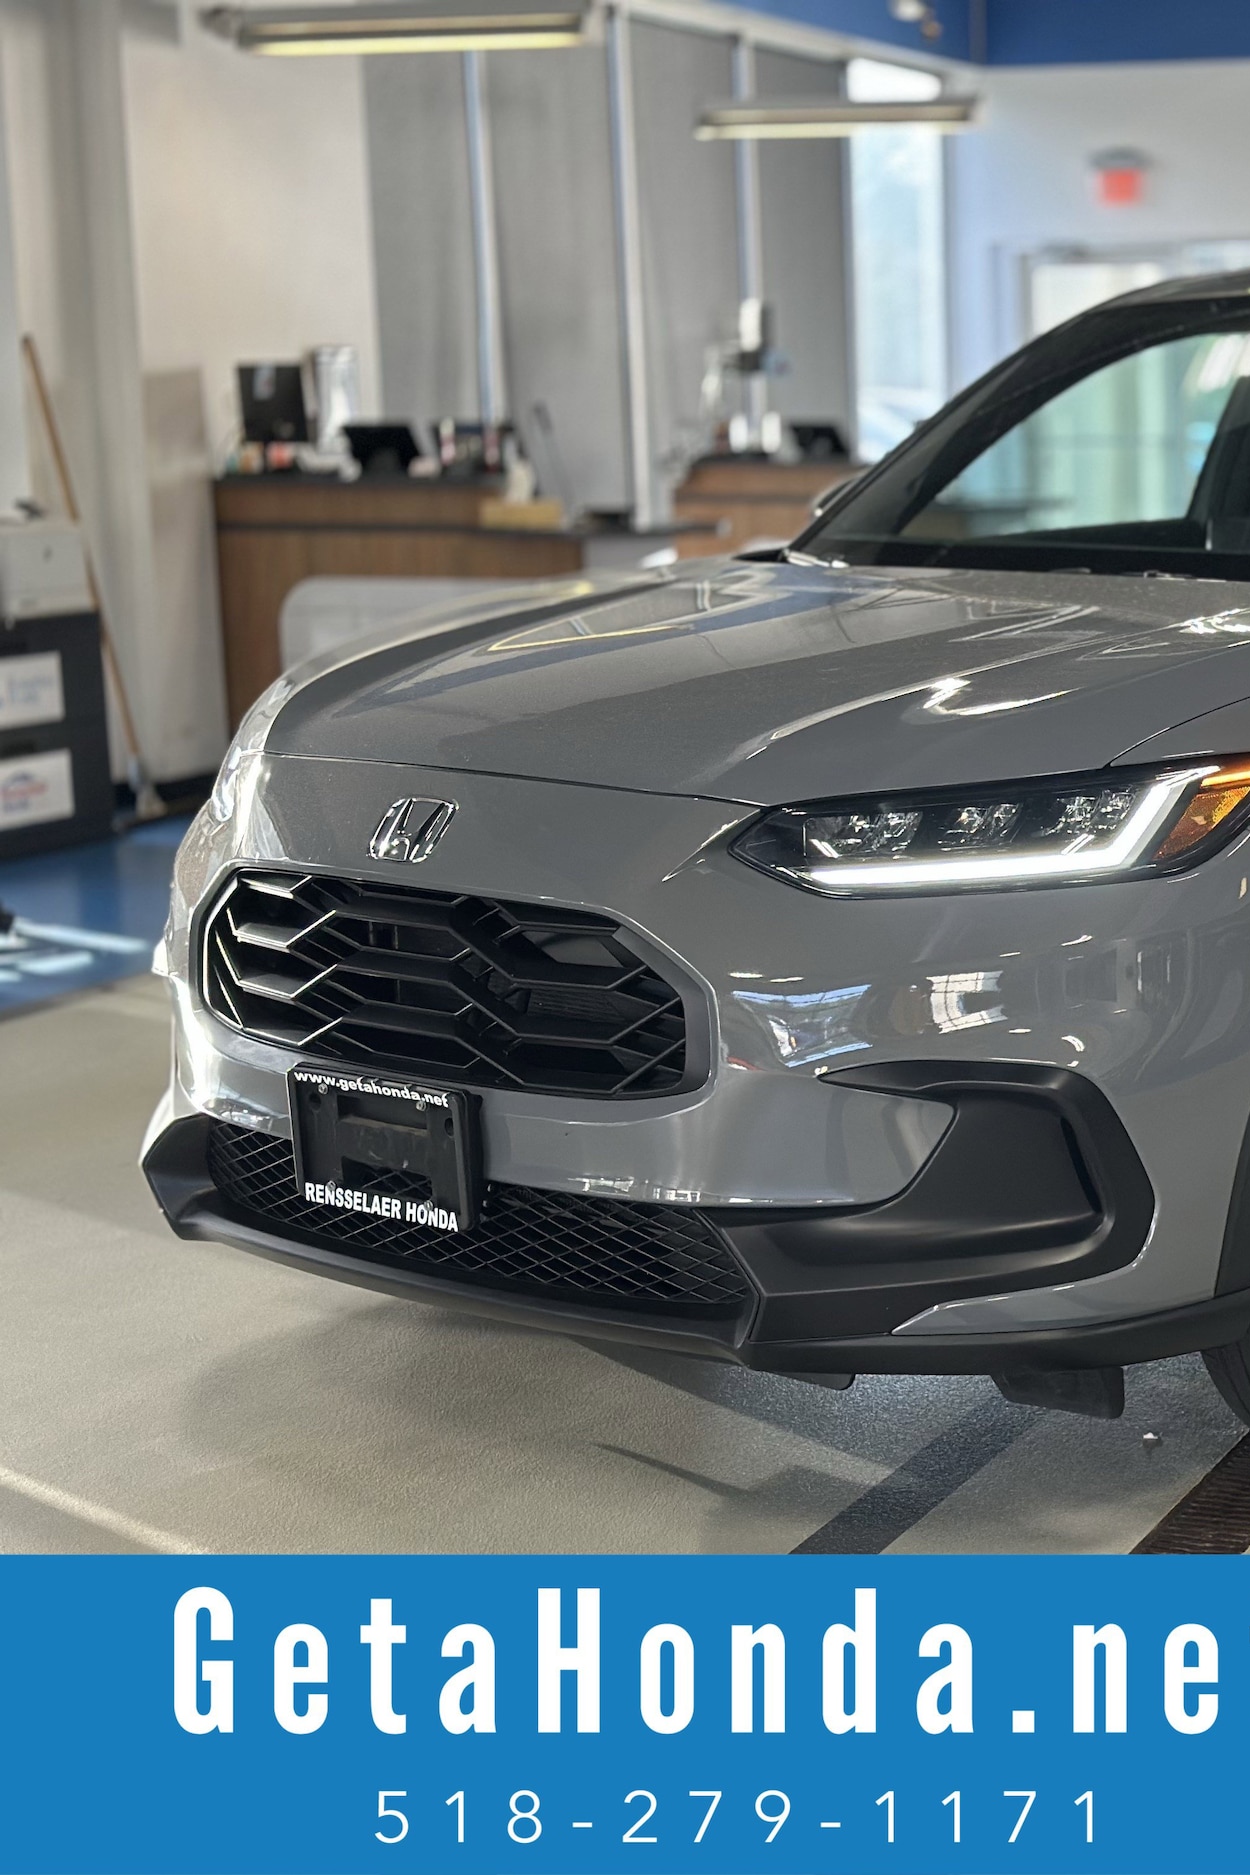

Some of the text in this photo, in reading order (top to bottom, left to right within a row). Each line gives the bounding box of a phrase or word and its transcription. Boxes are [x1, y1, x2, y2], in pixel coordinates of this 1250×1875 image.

[294, 1071, 449, 1108] www.getahonda.net
[304, 1182, 459, 1233] RENSSELAER HONDA
